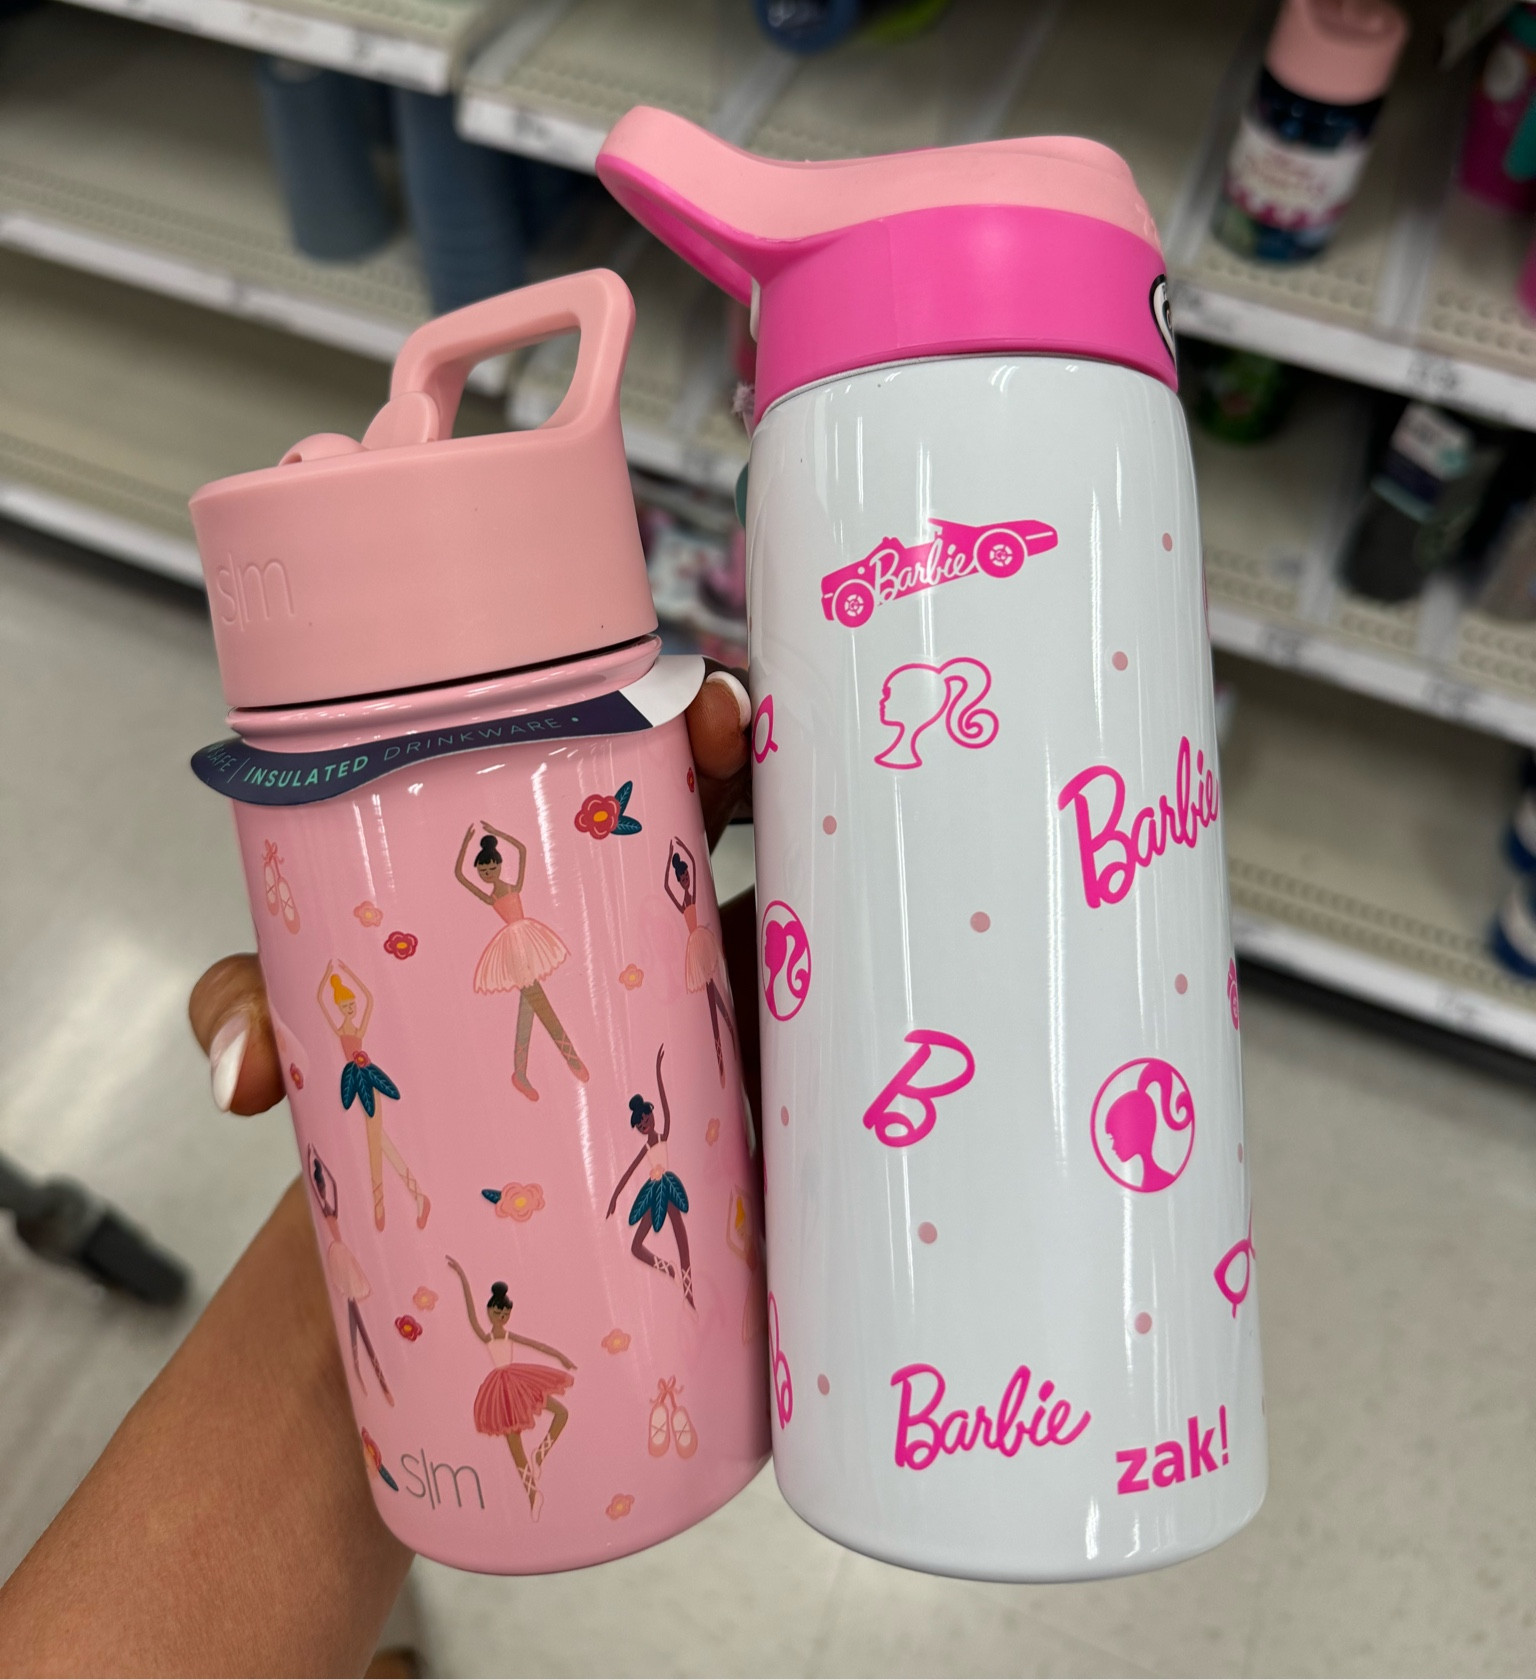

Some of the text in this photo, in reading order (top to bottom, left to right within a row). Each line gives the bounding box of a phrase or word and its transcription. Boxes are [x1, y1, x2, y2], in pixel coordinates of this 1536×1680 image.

[869, 538, 978, 603] Barbie
[243, 755, 368, 788] INSULATED
[384, 718, 562, 761] DRINKWARE
[1058, 736, 1219, 909] Barbie
[890, 1363, 1091, 1471] Barbie
[1116, 1405, 1229, 1495] zak!
